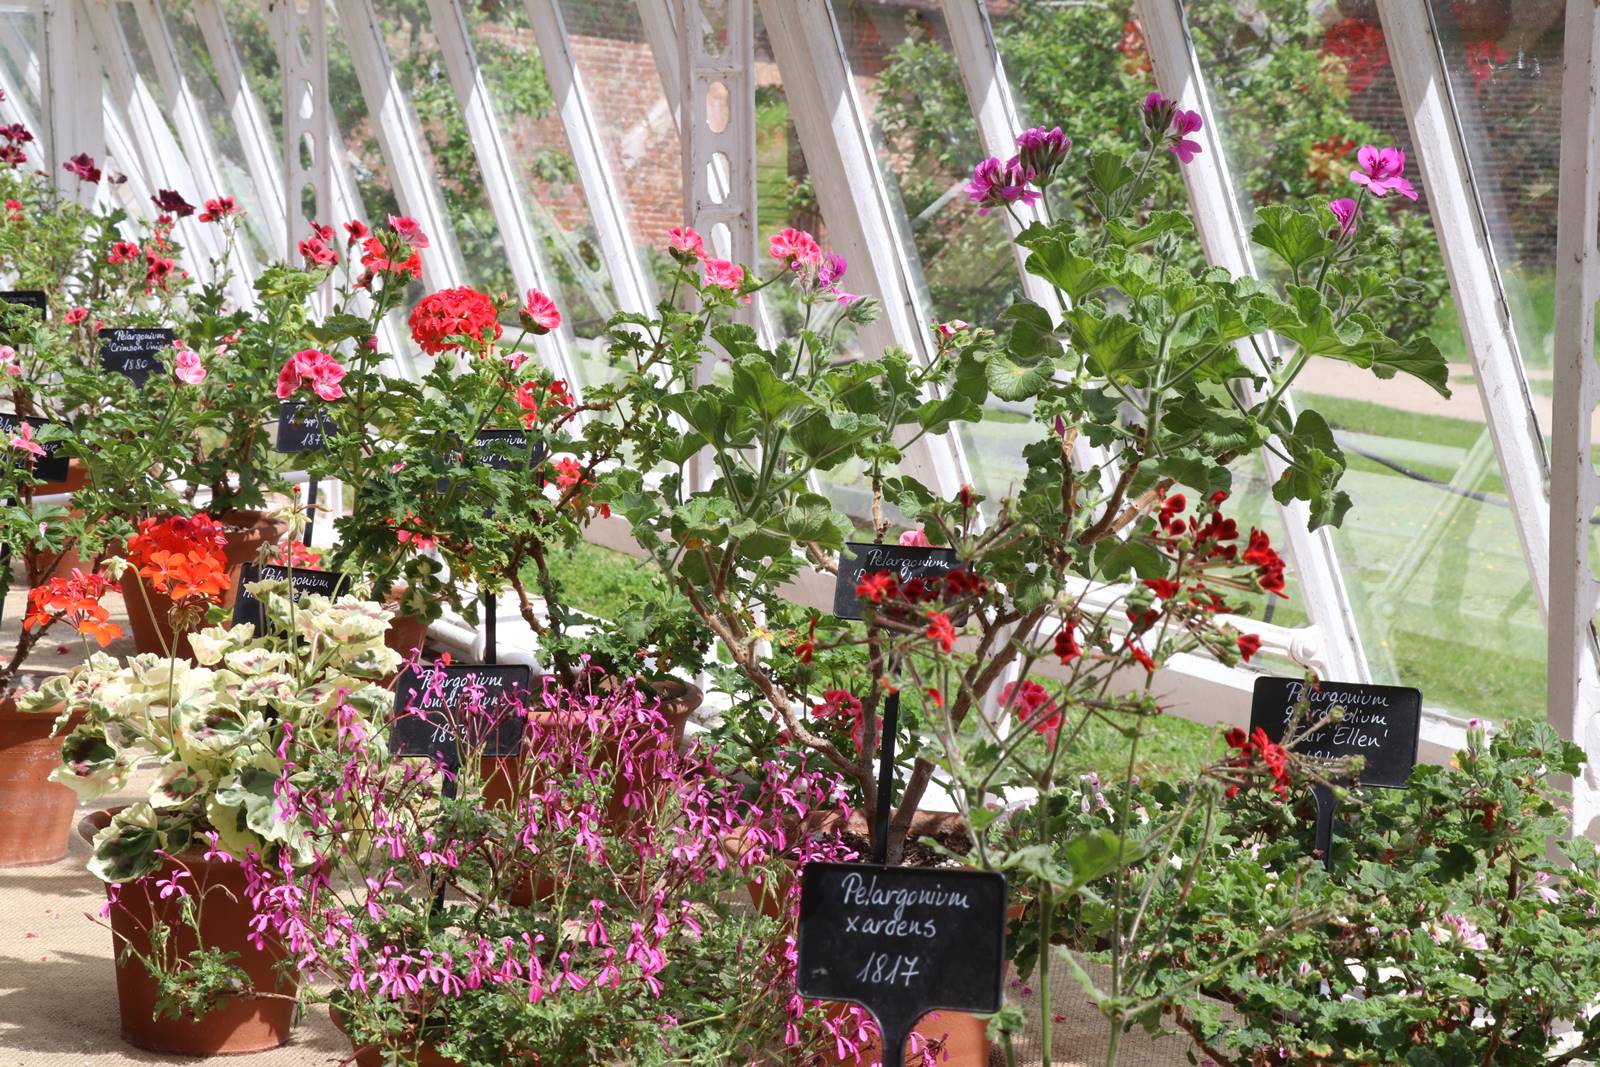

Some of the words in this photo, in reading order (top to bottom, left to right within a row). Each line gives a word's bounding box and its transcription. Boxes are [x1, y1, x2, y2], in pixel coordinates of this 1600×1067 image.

[114, 329, 165, 346] Pelargonium
[122, 358, 148, 371] 1880
[301, 433, 328, 446] 187
[261, 567, 328, 588] Pelagonium
[841, 872, 971, 919] Pelargonium
[856, 952, 920, 987] 1817
